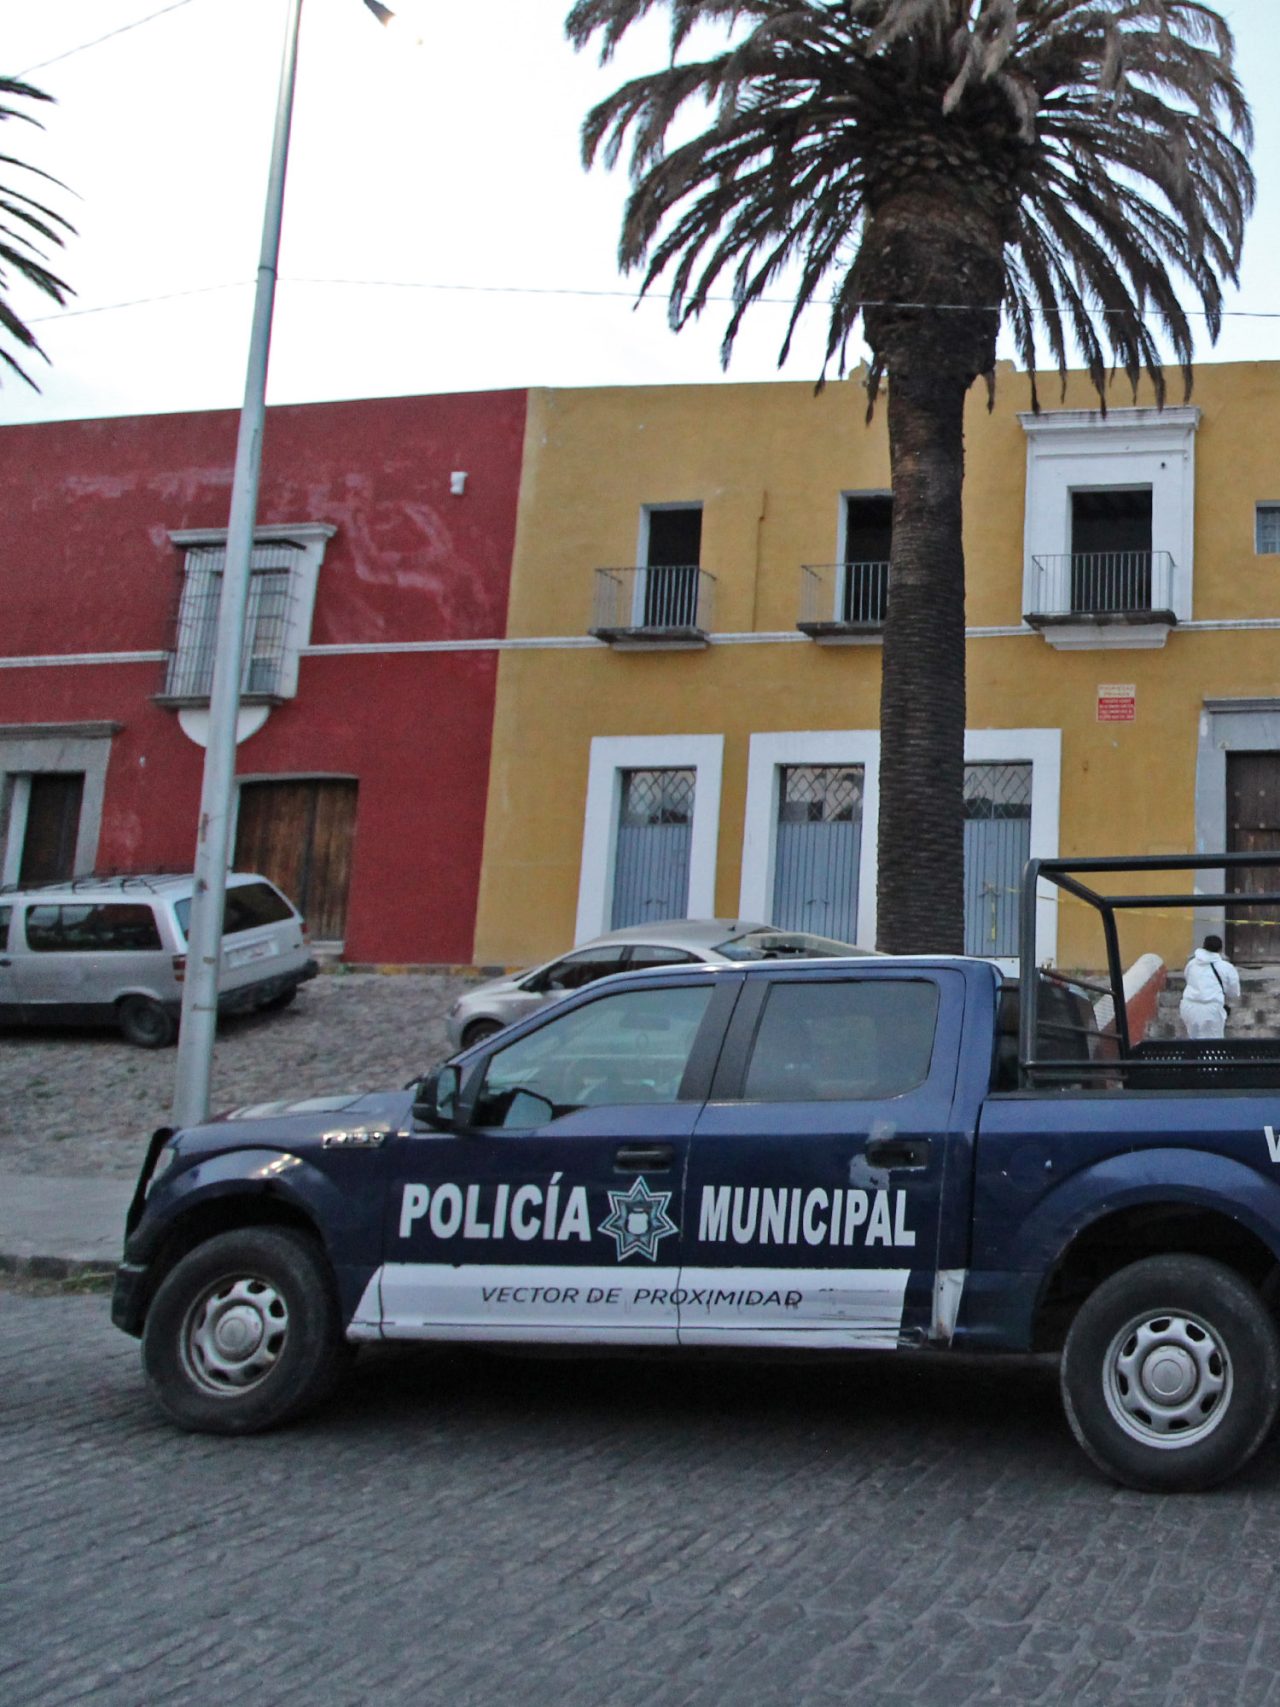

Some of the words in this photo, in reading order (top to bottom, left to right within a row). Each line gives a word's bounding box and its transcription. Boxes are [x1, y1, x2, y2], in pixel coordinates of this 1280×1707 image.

[399, 1171, 592, 1242] POLICÍA
[698, 1185, 916, 1247] MUNICIPAL
[481, 1286, 580, 1304] VECTOR
[586, 1287, 624, 1304] DE
[633, 1287, 805, 1307] PROXIMIDAD
